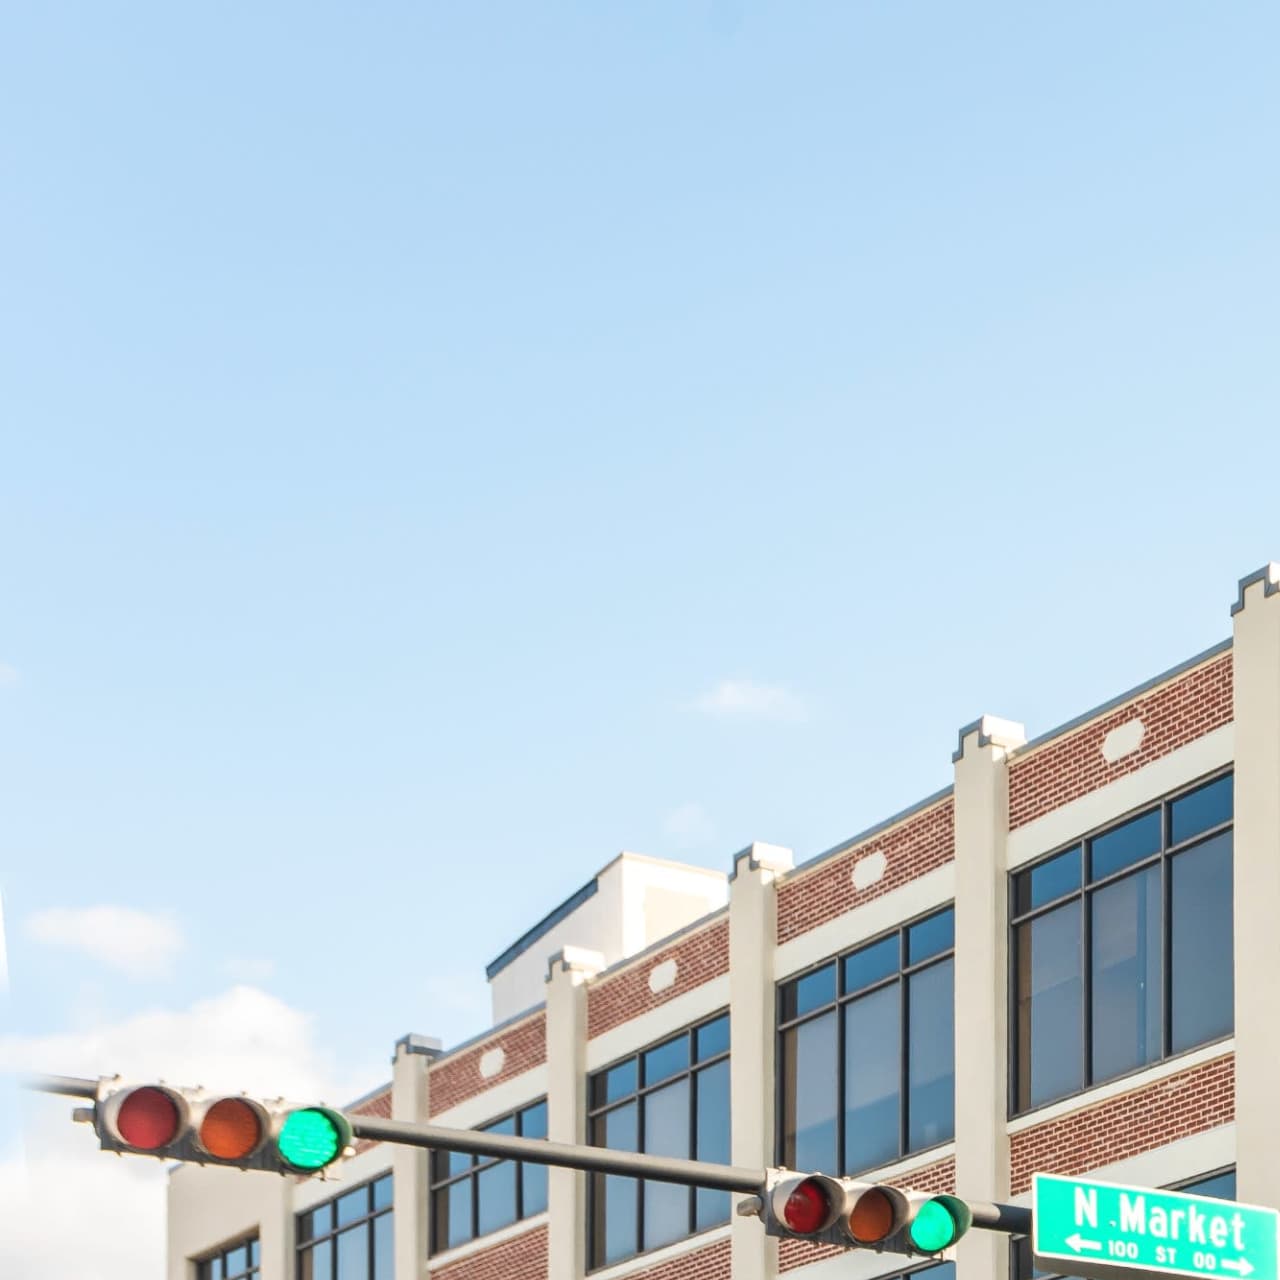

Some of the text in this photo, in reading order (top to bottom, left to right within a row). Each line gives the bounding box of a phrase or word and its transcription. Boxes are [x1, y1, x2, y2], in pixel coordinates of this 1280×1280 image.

[1119, 1193, 1246, 1251] Market
[1108, 1239, 1217, 1270] 100 ST 00
